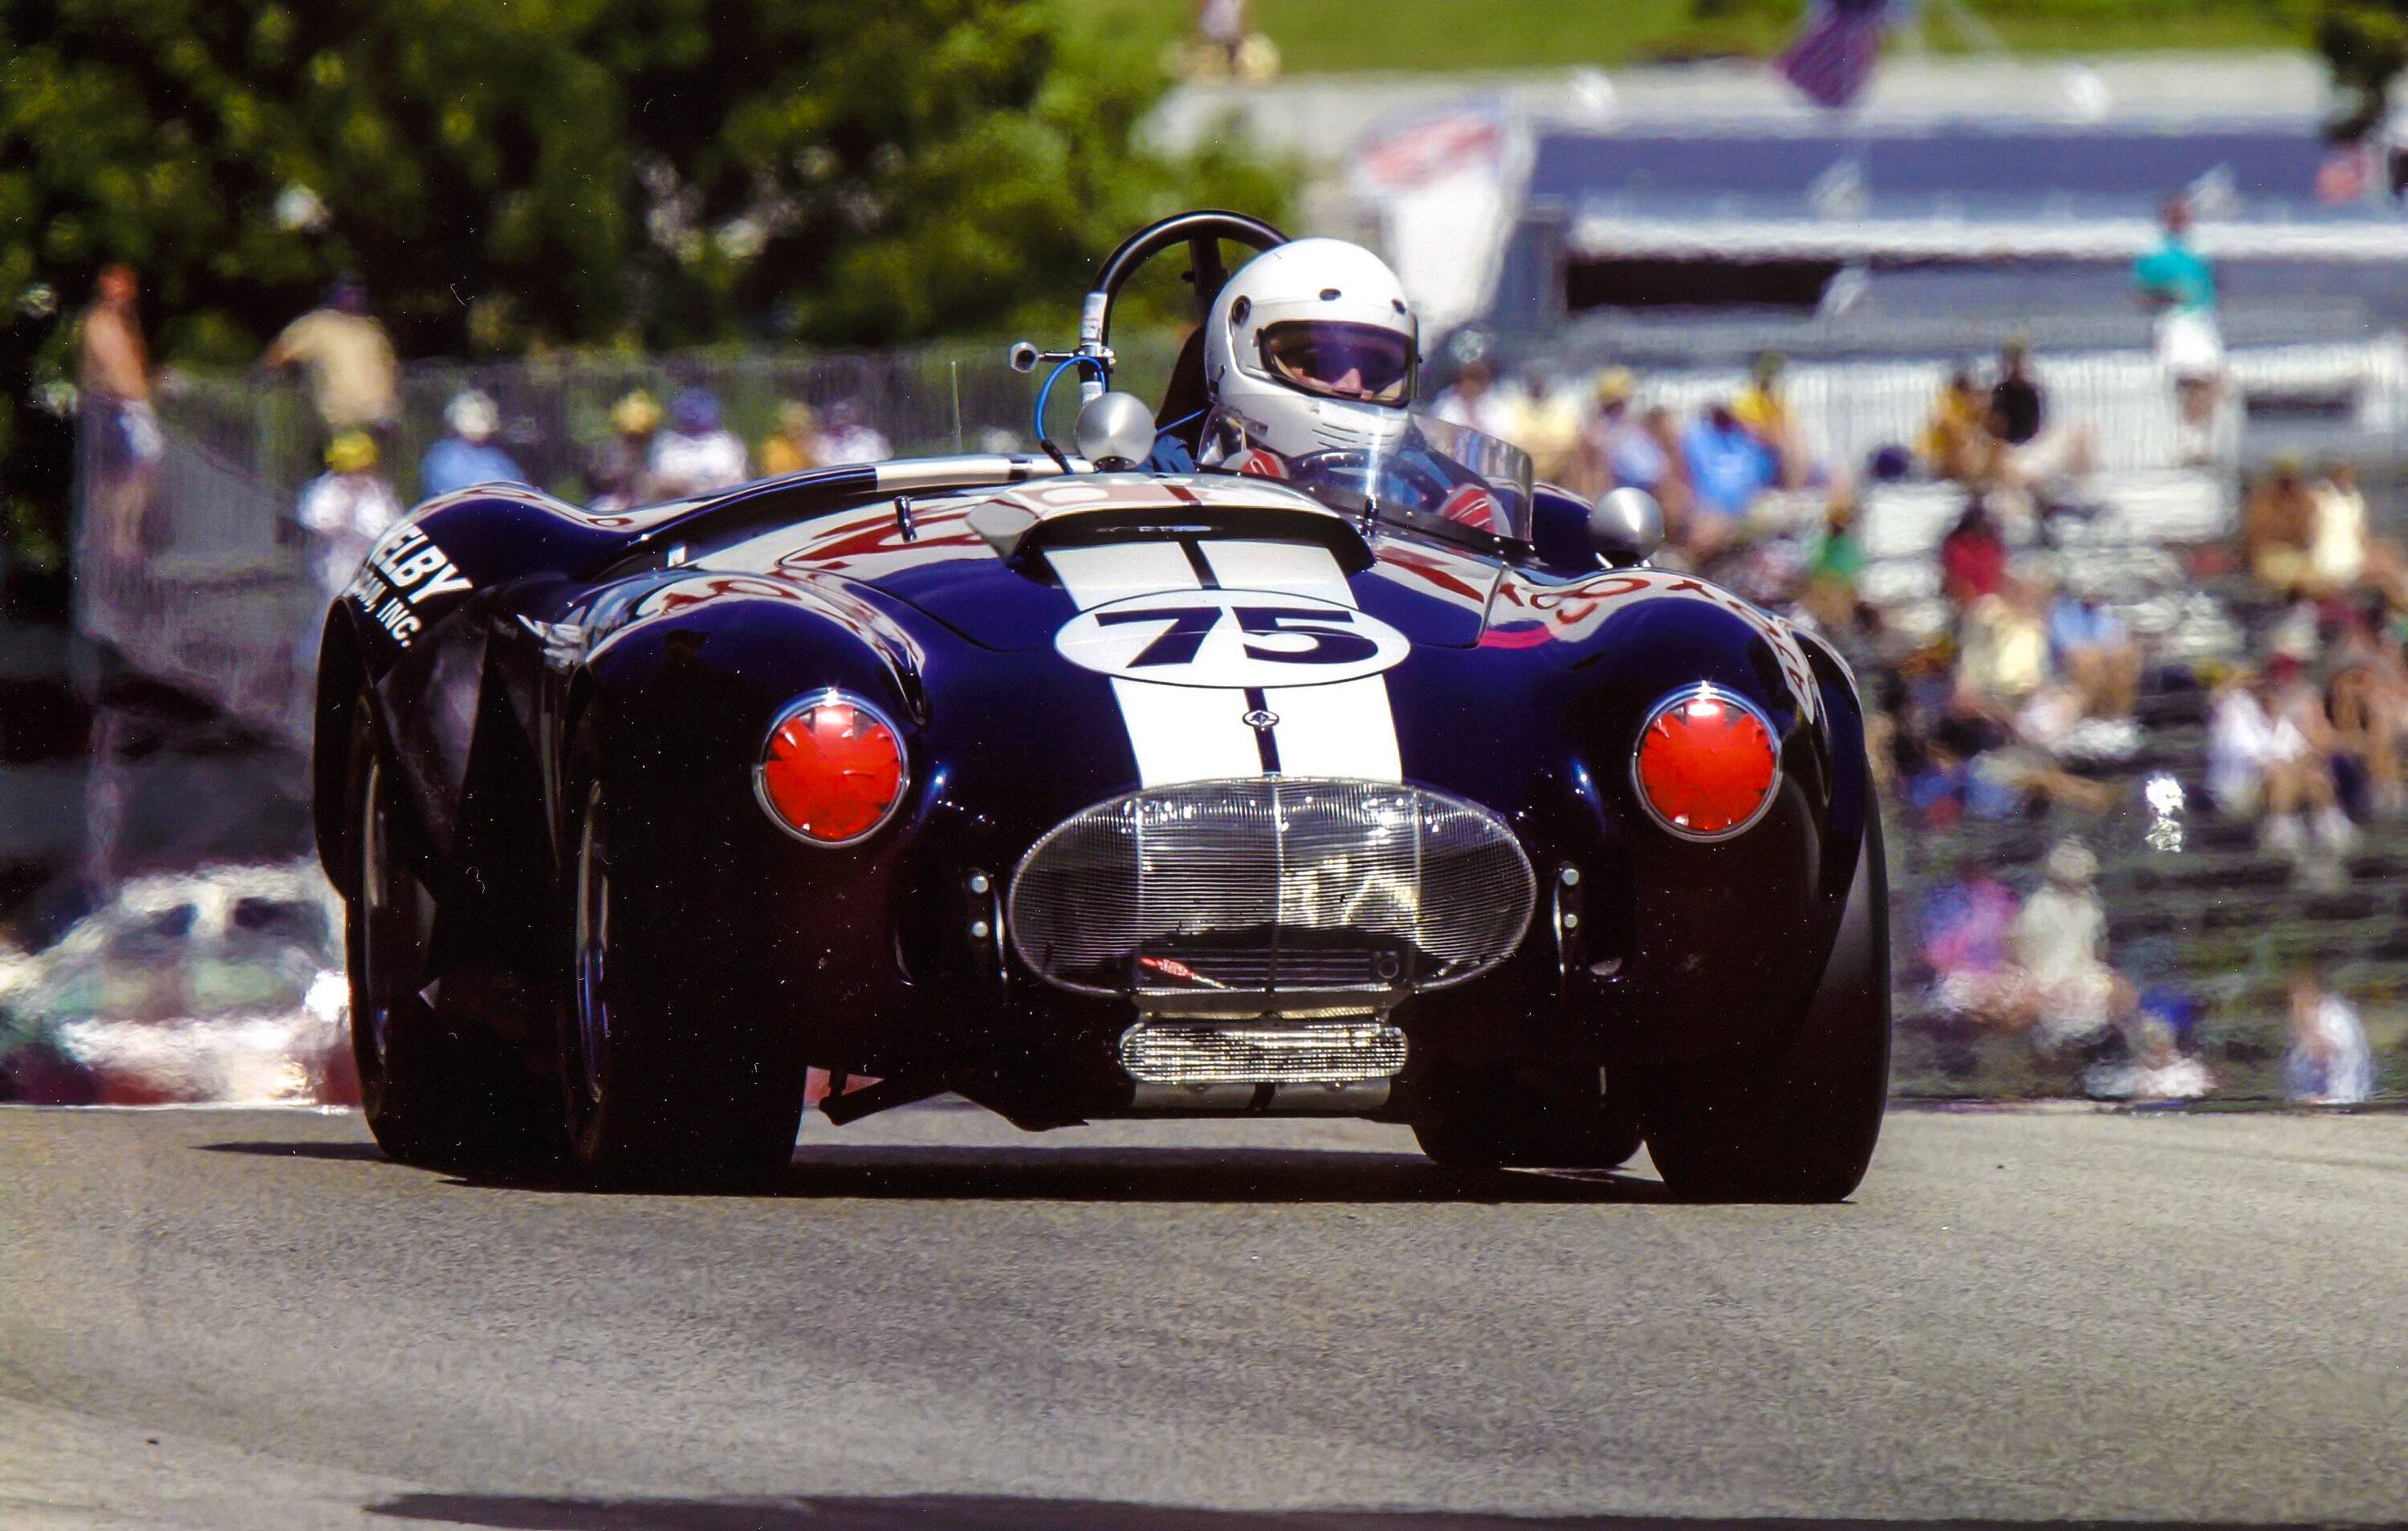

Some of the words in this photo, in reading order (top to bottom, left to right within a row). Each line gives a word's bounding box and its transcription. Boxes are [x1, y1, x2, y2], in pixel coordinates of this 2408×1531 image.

[371, 522, 474, 604] ELBY
[376, 596, 422, 648] INC.
[1094, 605, 1380, 668] 75
